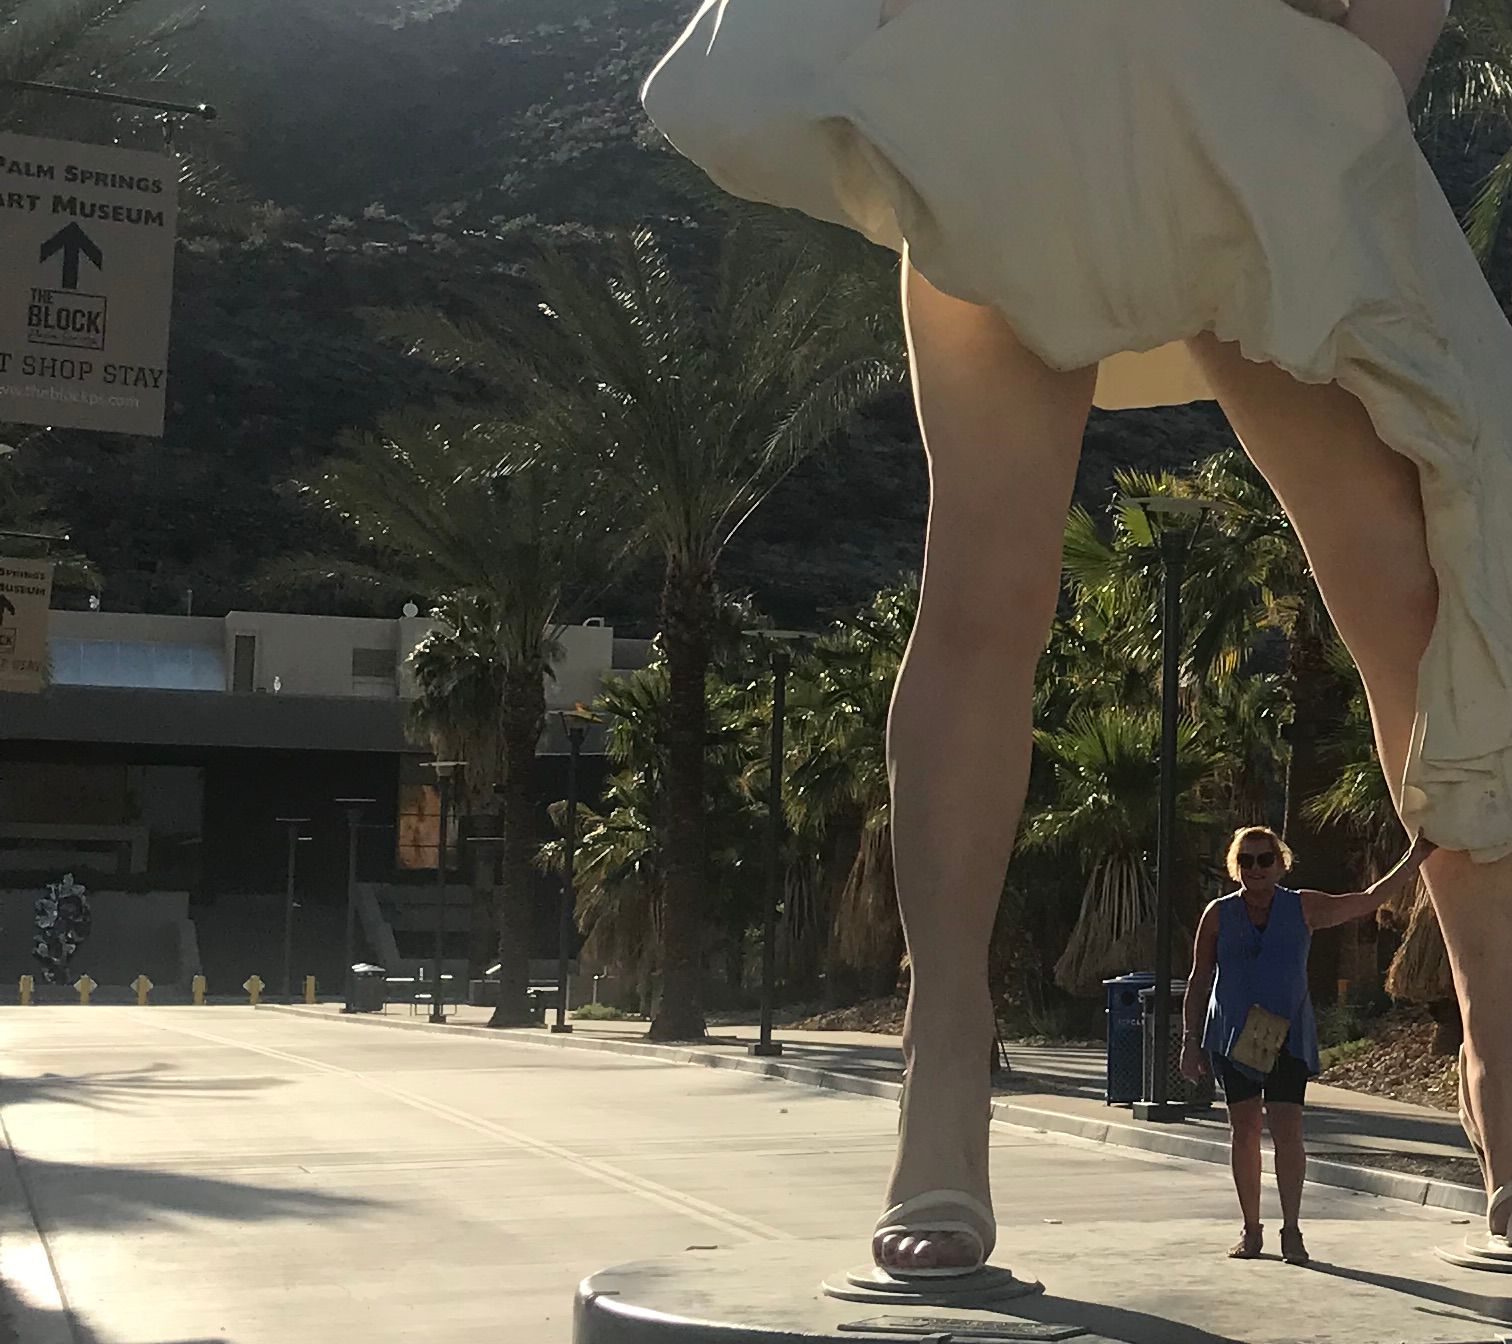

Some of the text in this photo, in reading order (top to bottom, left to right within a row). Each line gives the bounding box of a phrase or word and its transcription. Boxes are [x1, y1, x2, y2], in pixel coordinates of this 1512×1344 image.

[64, 164, 163, 194] SPRINGS
[52, 194, 164, 227] MUSEUM
[30, 288, 54, 305] THE
[27, 304, 103, 334] BLOCK
[22, 355, 93, 381] SHOP
[103, 364, 164, 389] STAY
